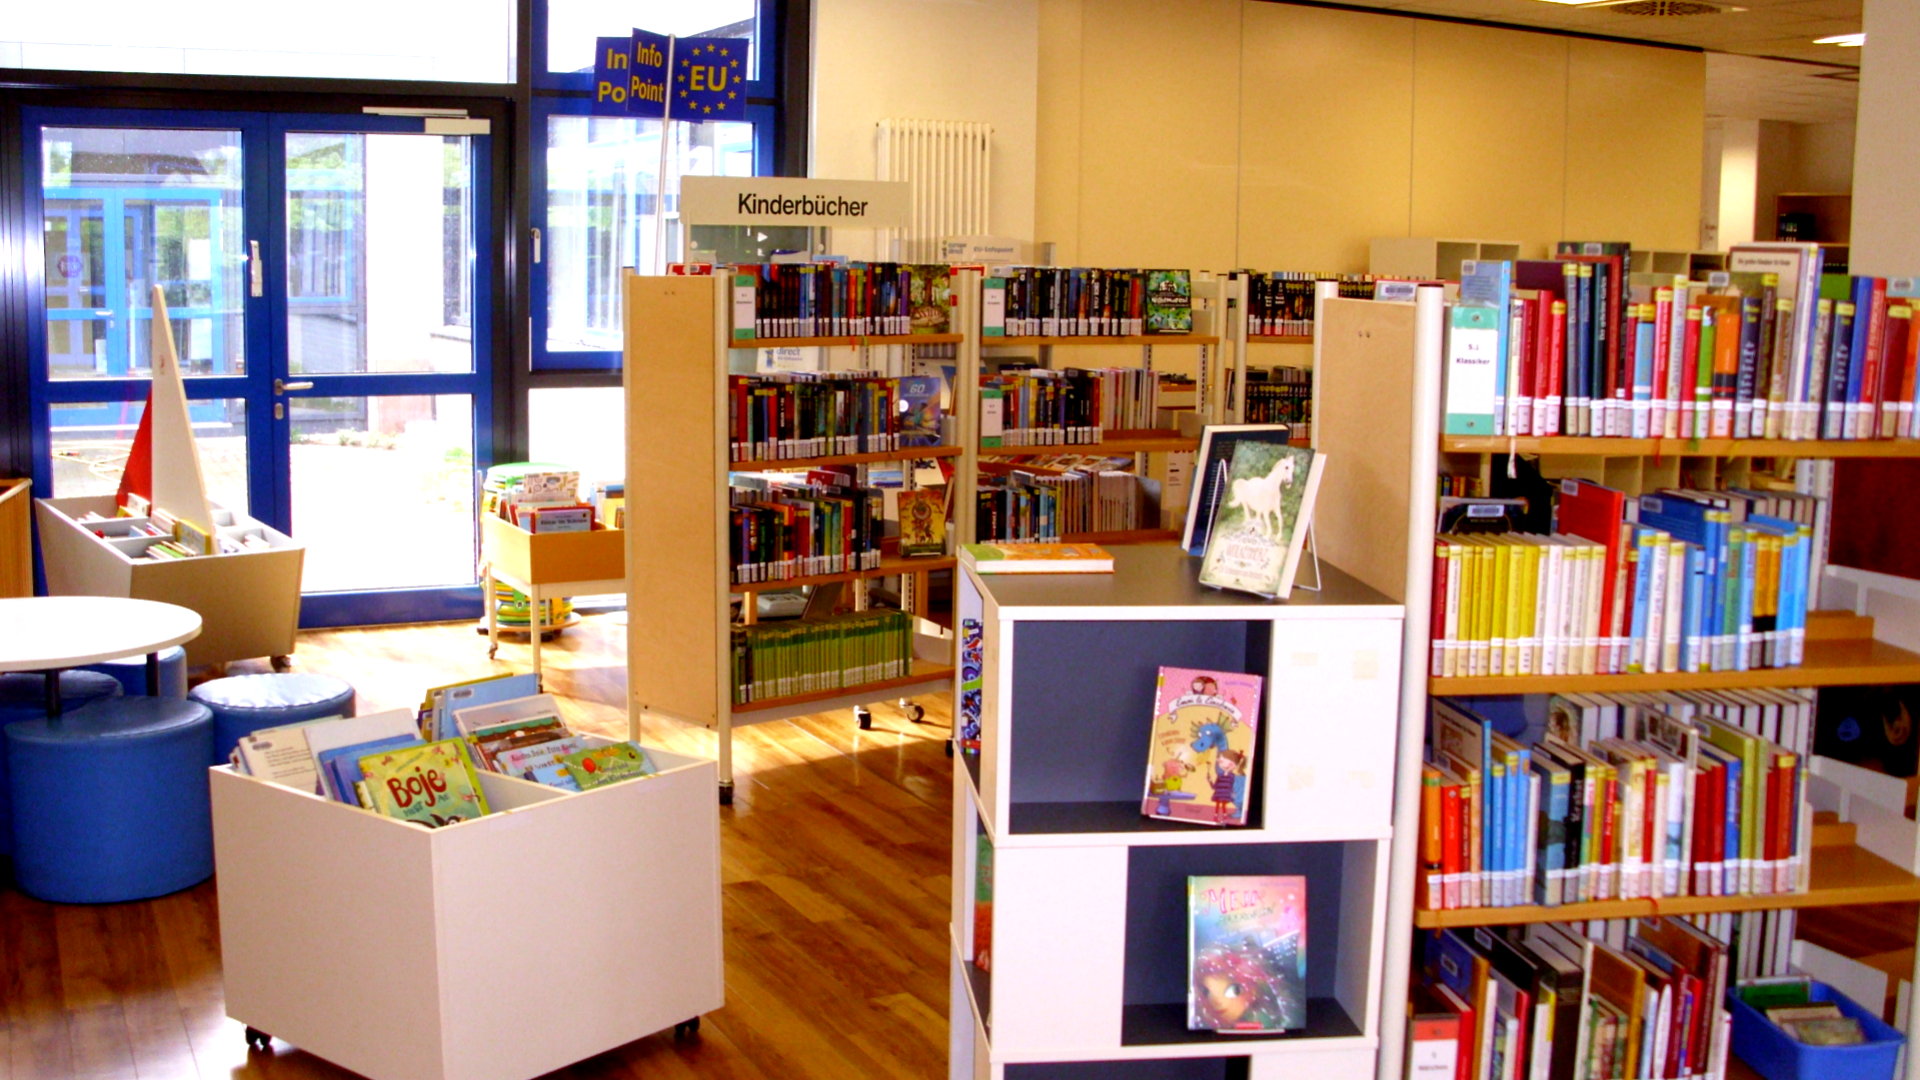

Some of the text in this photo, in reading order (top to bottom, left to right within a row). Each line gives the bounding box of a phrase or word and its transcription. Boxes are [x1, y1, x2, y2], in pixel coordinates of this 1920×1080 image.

[606, 48, 628, 70] In
[636, 41, 662, 68] Info
[598, 81, 626, 103] Po
[631, 75, 664, 103] Point
[690, 66, 728, 92] EU
[737, 192, 868, 217] Kinderbücher
[1456, 357, 1490, 365] Klassiker
[909, 383, 926, 394] 60
[387, 766, 447, 809] Boje
[1570, 779, 1582, 822] Krabat
[1200, 886, 1268, 917] MEJA
